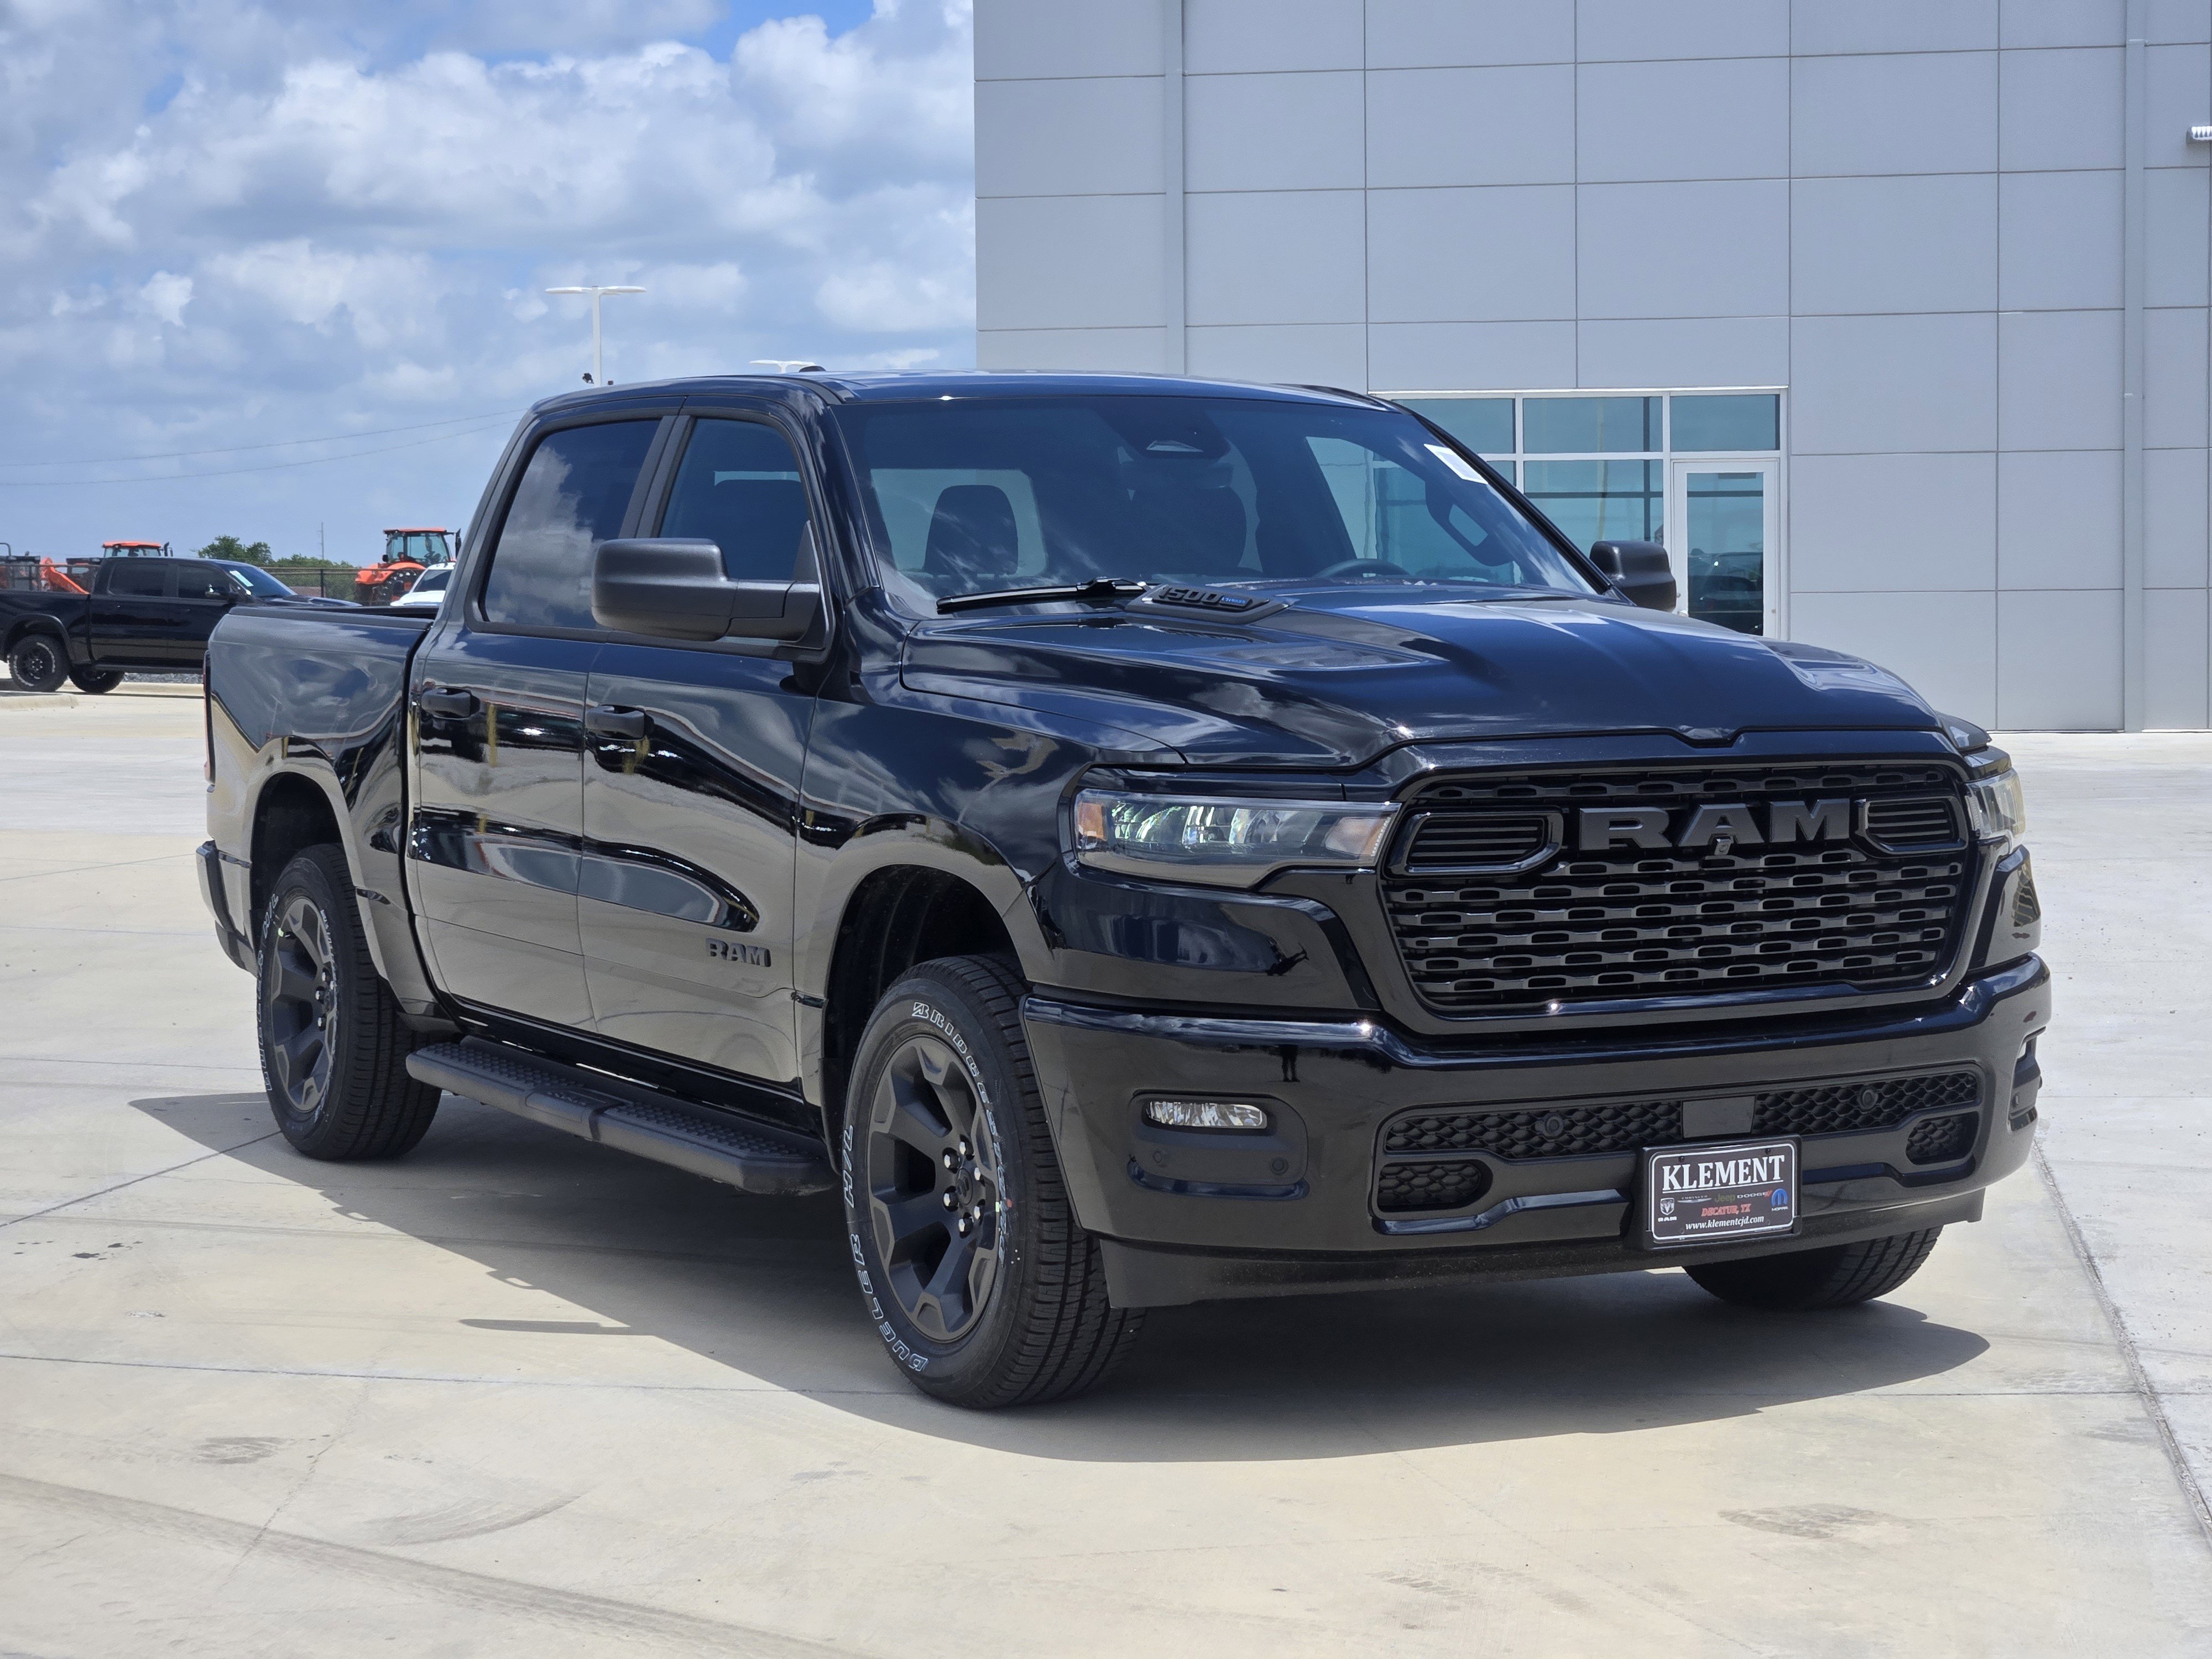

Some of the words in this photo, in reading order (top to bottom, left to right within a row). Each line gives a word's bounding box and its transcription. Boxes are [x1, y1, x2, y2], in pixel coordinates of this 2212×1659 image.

[1159, 585, 1220, 605] 1500
[1579, 798, 1850, 851] RAM
[705, 937, 771, 968] RAM
[843, 1125, 854, 1209] H/L
[1662, 1155, 1785, 1191] KLEMENT
[1714, 1193, 1735, 1203] Jeep
[1741, 1203, 1752, 1213] TX
[1686, 1215, 1765, 1230] www.klementcjd.com
[851, 1233, 928, 1372] DUELER
